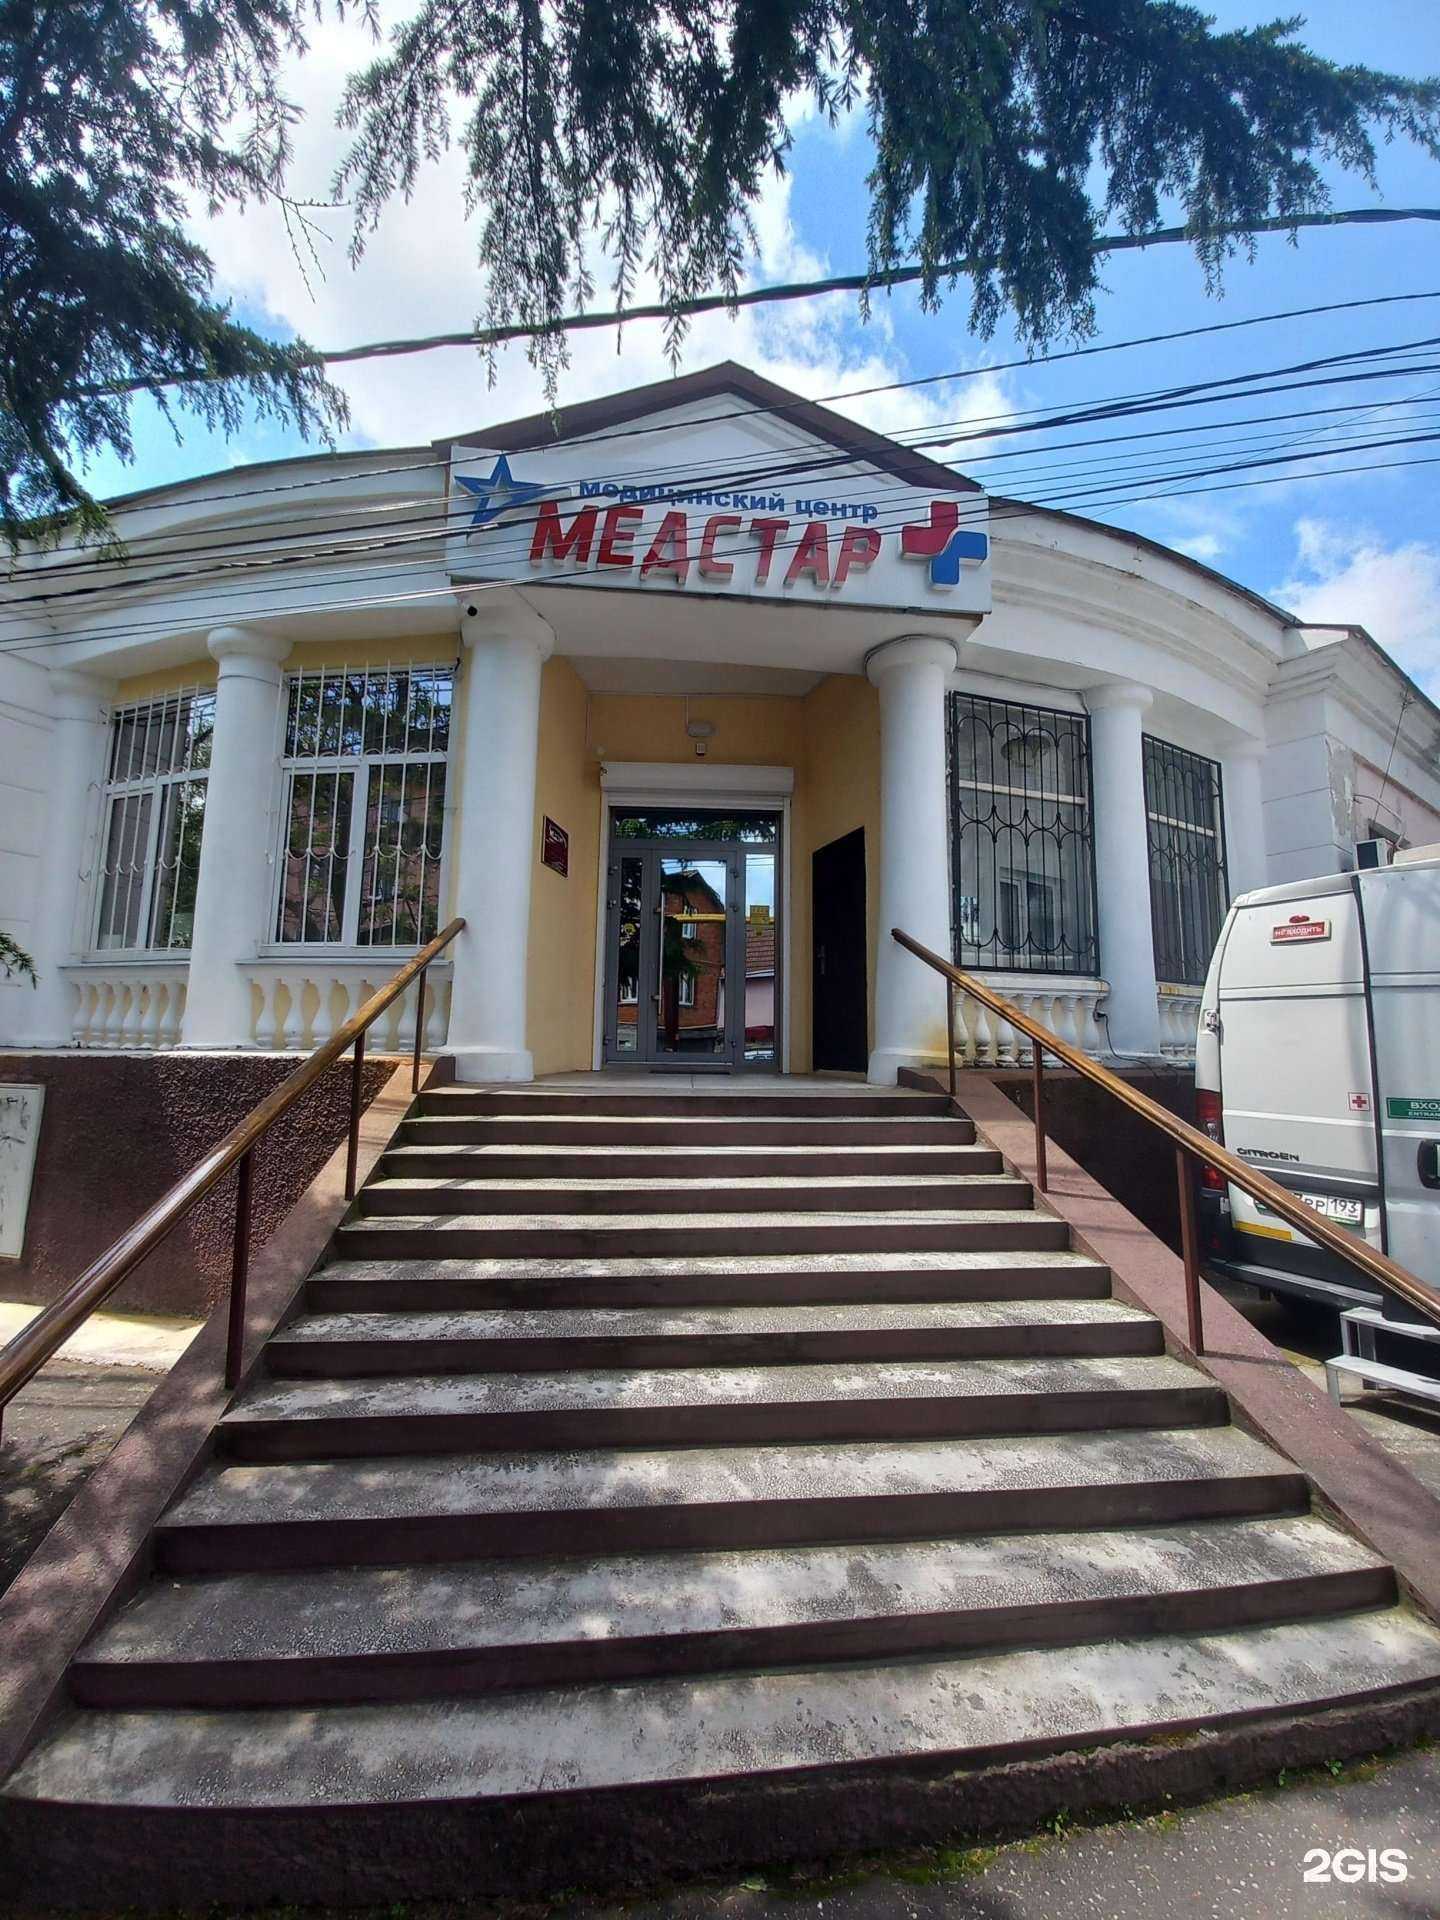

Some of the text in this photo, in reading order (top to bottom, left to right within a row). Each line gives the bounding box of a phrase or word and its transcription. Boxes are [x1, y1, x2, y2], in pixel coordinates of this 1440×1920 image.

[796, 499, 878, 524] центр
[528, 501, 882, 586] МЕДСТАР
[1410, 1101, 1440, 1110] ВХО
[1330, 1198, 1358, 1214] 193
